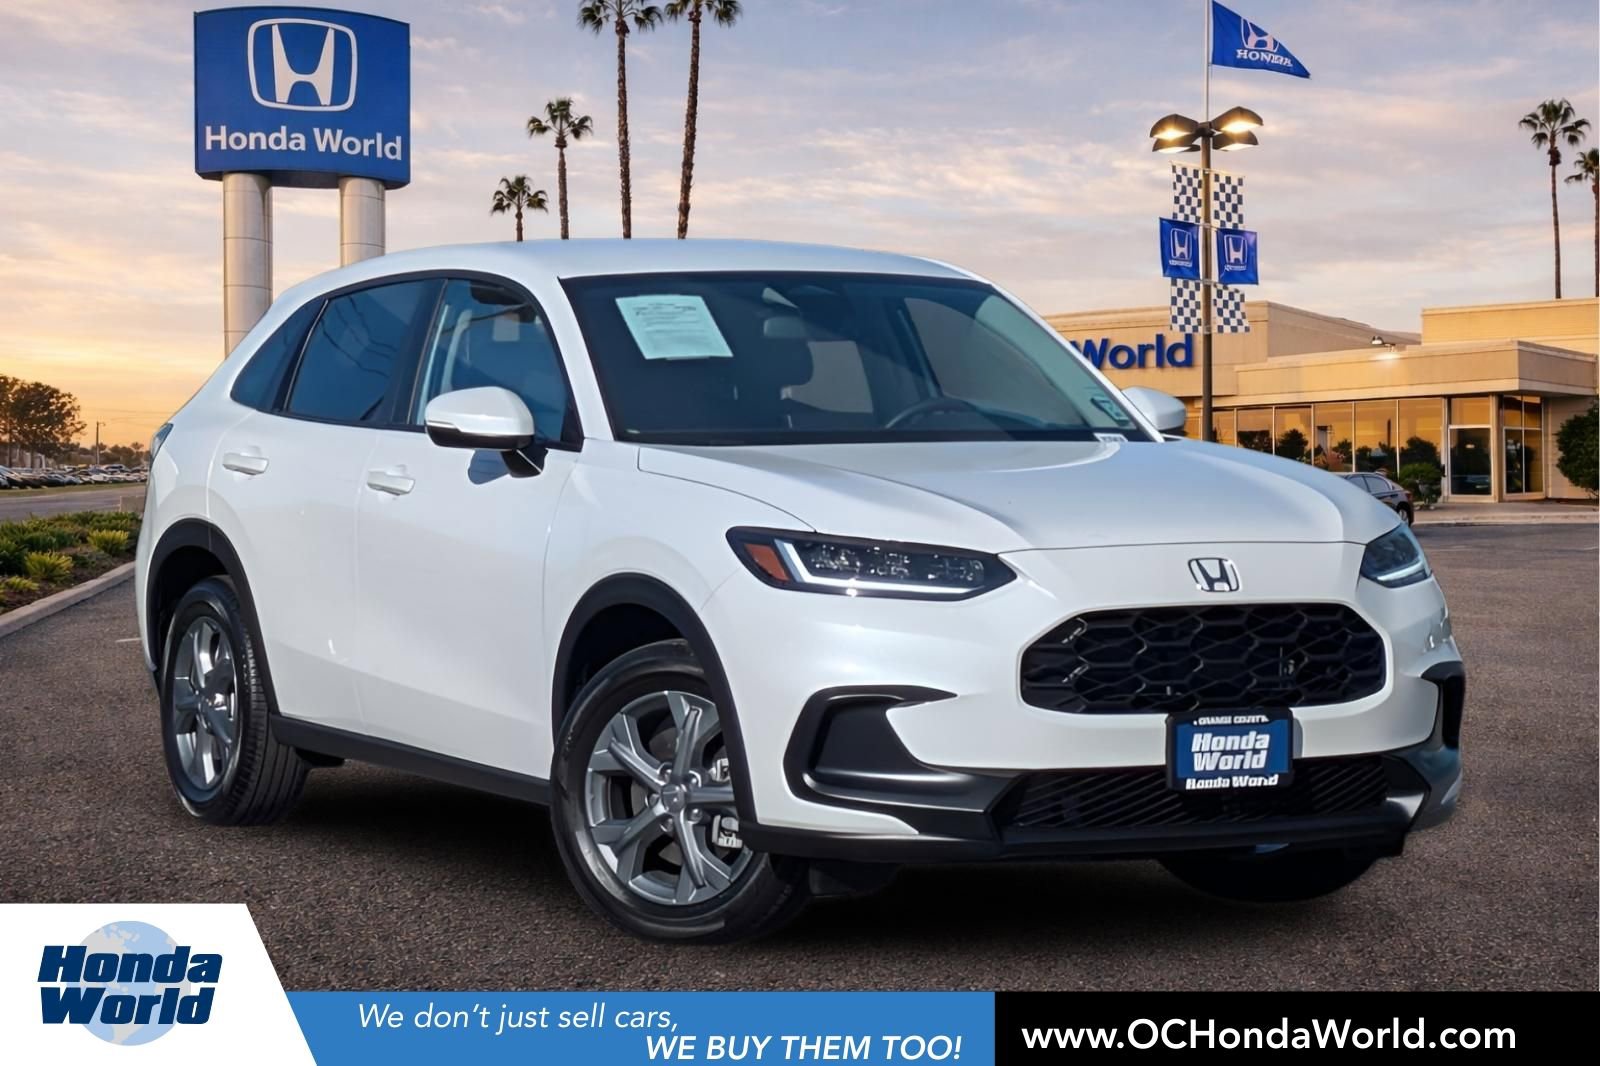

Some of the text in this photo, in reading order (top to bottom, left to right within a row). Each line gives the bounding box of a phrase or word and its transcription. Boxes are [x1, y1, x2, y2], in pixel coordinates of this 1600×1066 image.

[205, 125, 402, 161] Honda World
[1070, 333, 1194, 370] World
[1191, 730, 1270, 752] Honda
[1193, 749, 1268, 772] World
[1185, 776, 1231, 790] Honda
